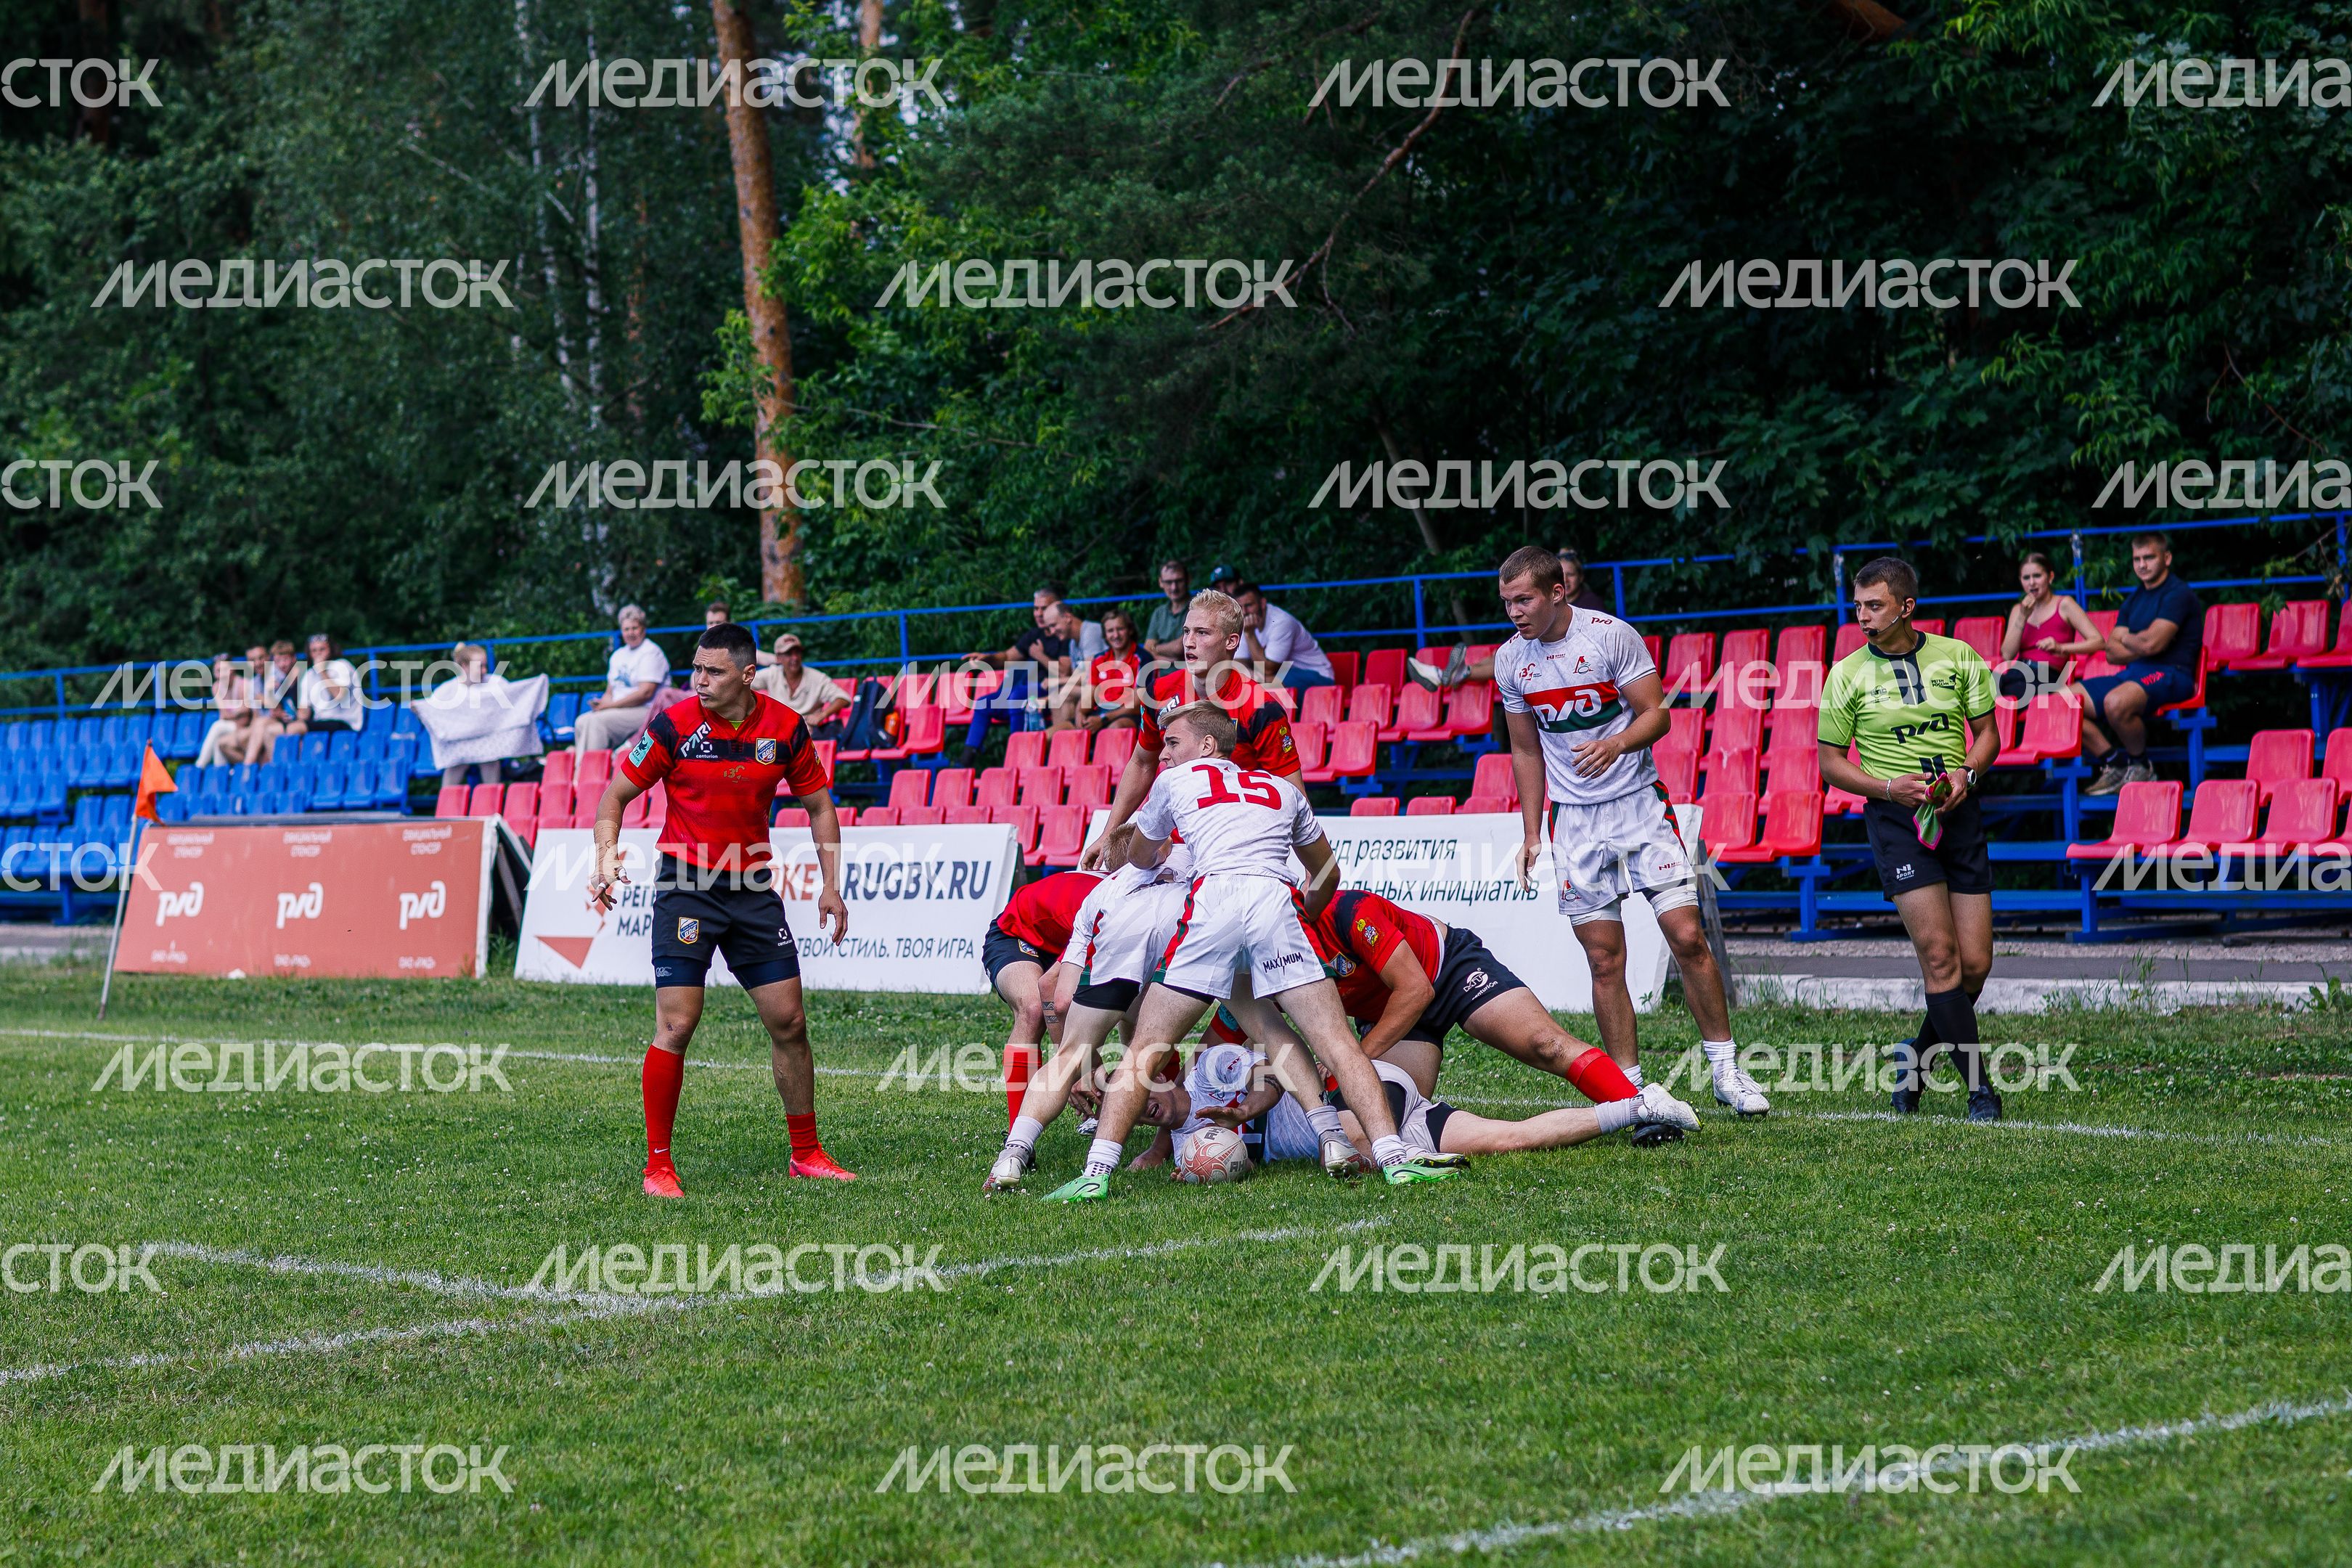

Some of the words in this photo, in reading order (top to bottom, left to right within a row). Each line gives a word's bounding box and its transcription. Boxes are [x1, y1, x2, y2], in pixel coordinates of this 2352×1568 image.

[680, 721, 712, 757] PARI
[1191, 764, 1282, 811] 15
[1330, 839, 1349, 865] нд
[1354, 838, 1457, 867] развития
[1896, 870, 1915, 880] SPORT
[1420, 879, 1539, 906] инициатив
[616, 914, 652, 936] МАР
[838, 936, 889, 959] СТИЛЬ.
[895, 937, 934, 959] ТВОЯ
[936, 937, 974, 959] ИГРА
[1262, 950, 1304, 975] MAXIMUM
